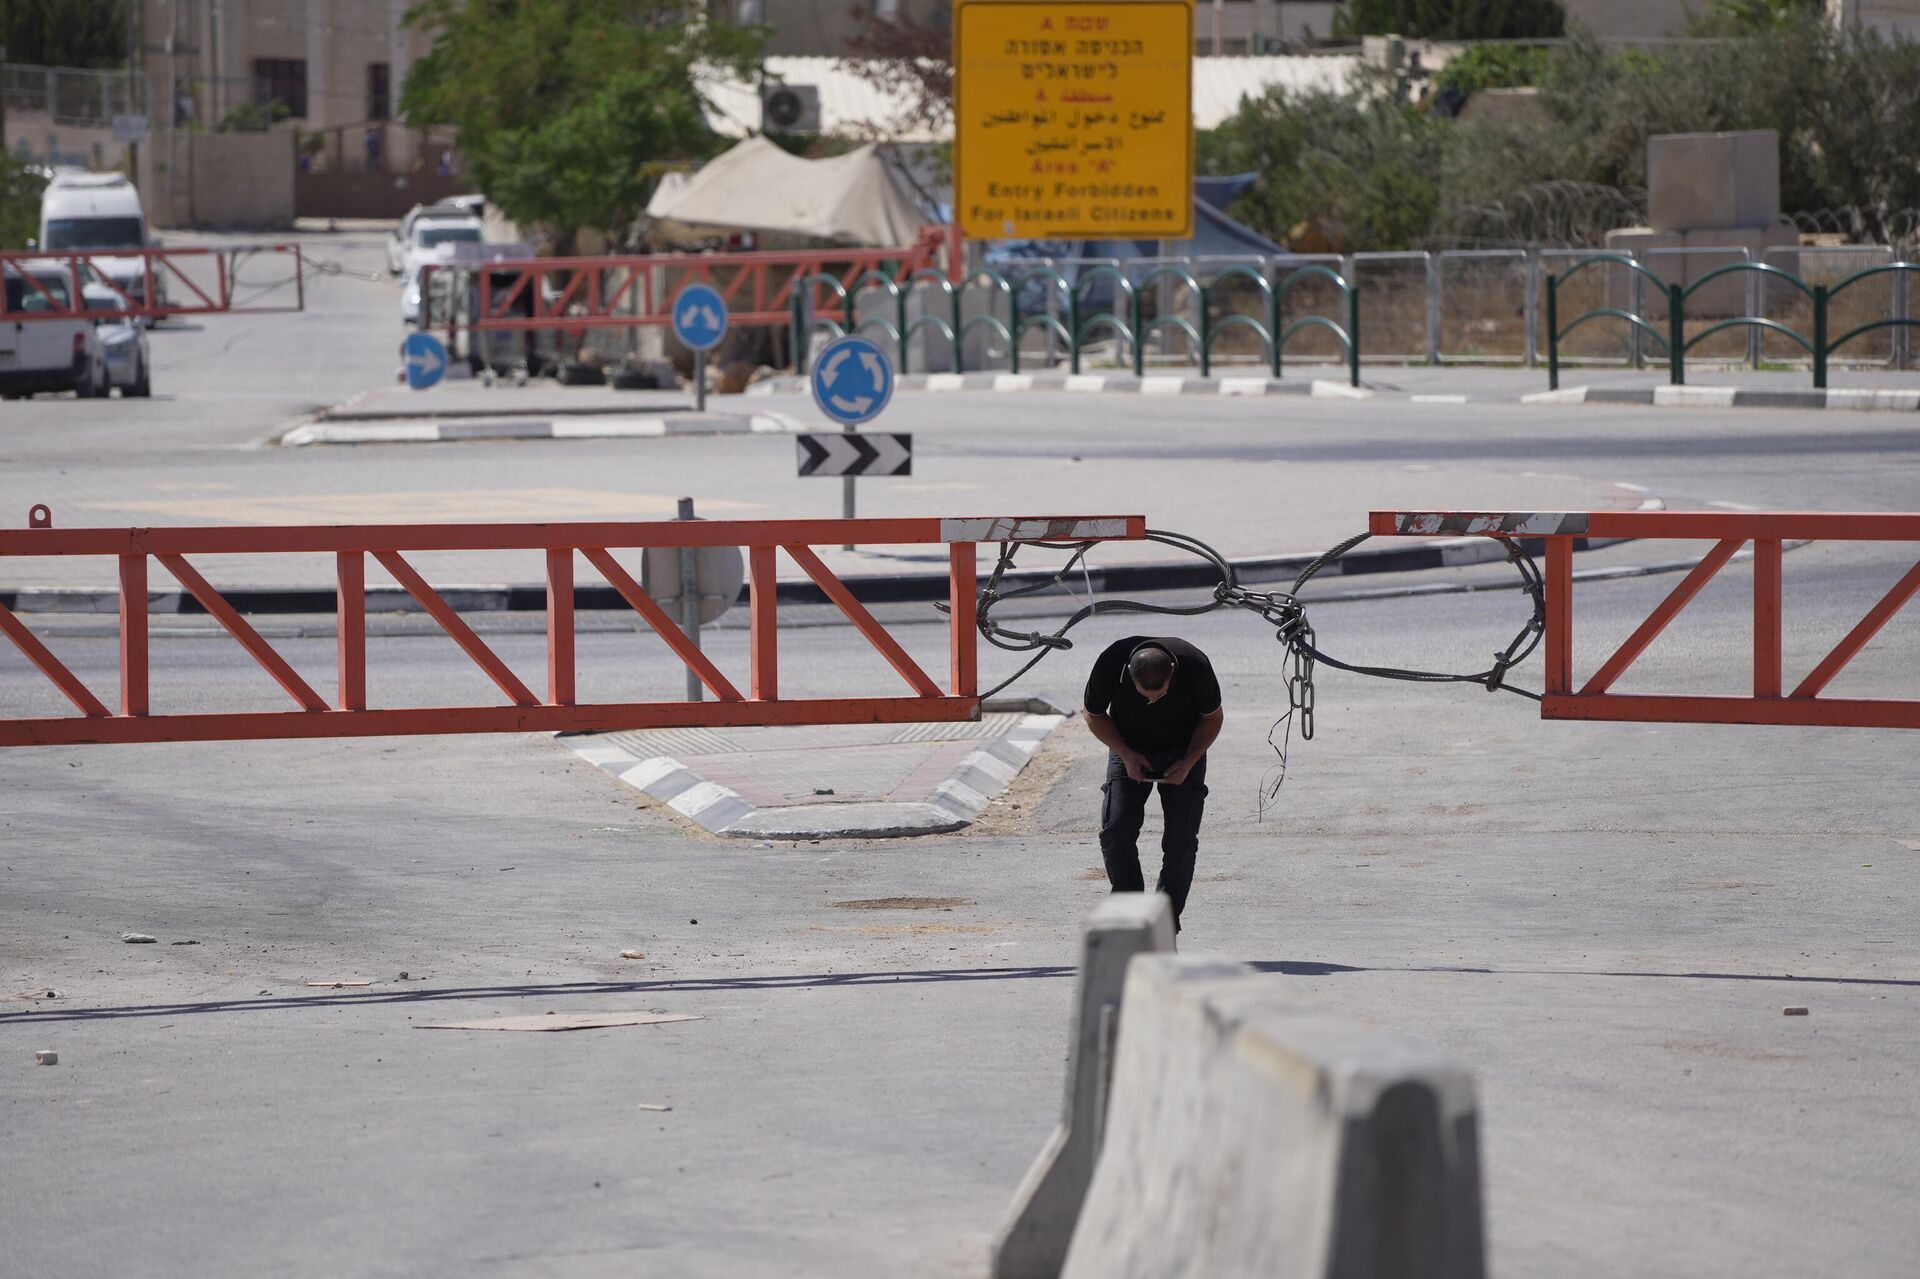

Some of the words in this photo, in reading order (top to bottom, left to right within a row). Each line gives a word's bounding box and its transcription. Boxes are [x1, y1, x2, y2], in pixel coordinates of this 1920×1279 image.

[1040, 17, 1054, 30] A
[1005, 39, 1067, 55] אסורה
[1075, 39, 1145, 55] הכניסה
[1021, 61, 1120, 79] לישראלים
[1035, 88, 1048, 103] A
[1031, 159, 1079, 174] Area
[987, 182, 1045, 202] Entry
[1053, 182, 1159, 198] Forbidden
[970, 205, 1004, 221] For
[1014, 206, 1080, 221] Israeli
[1089, 205, 1175, 222] Citizens
